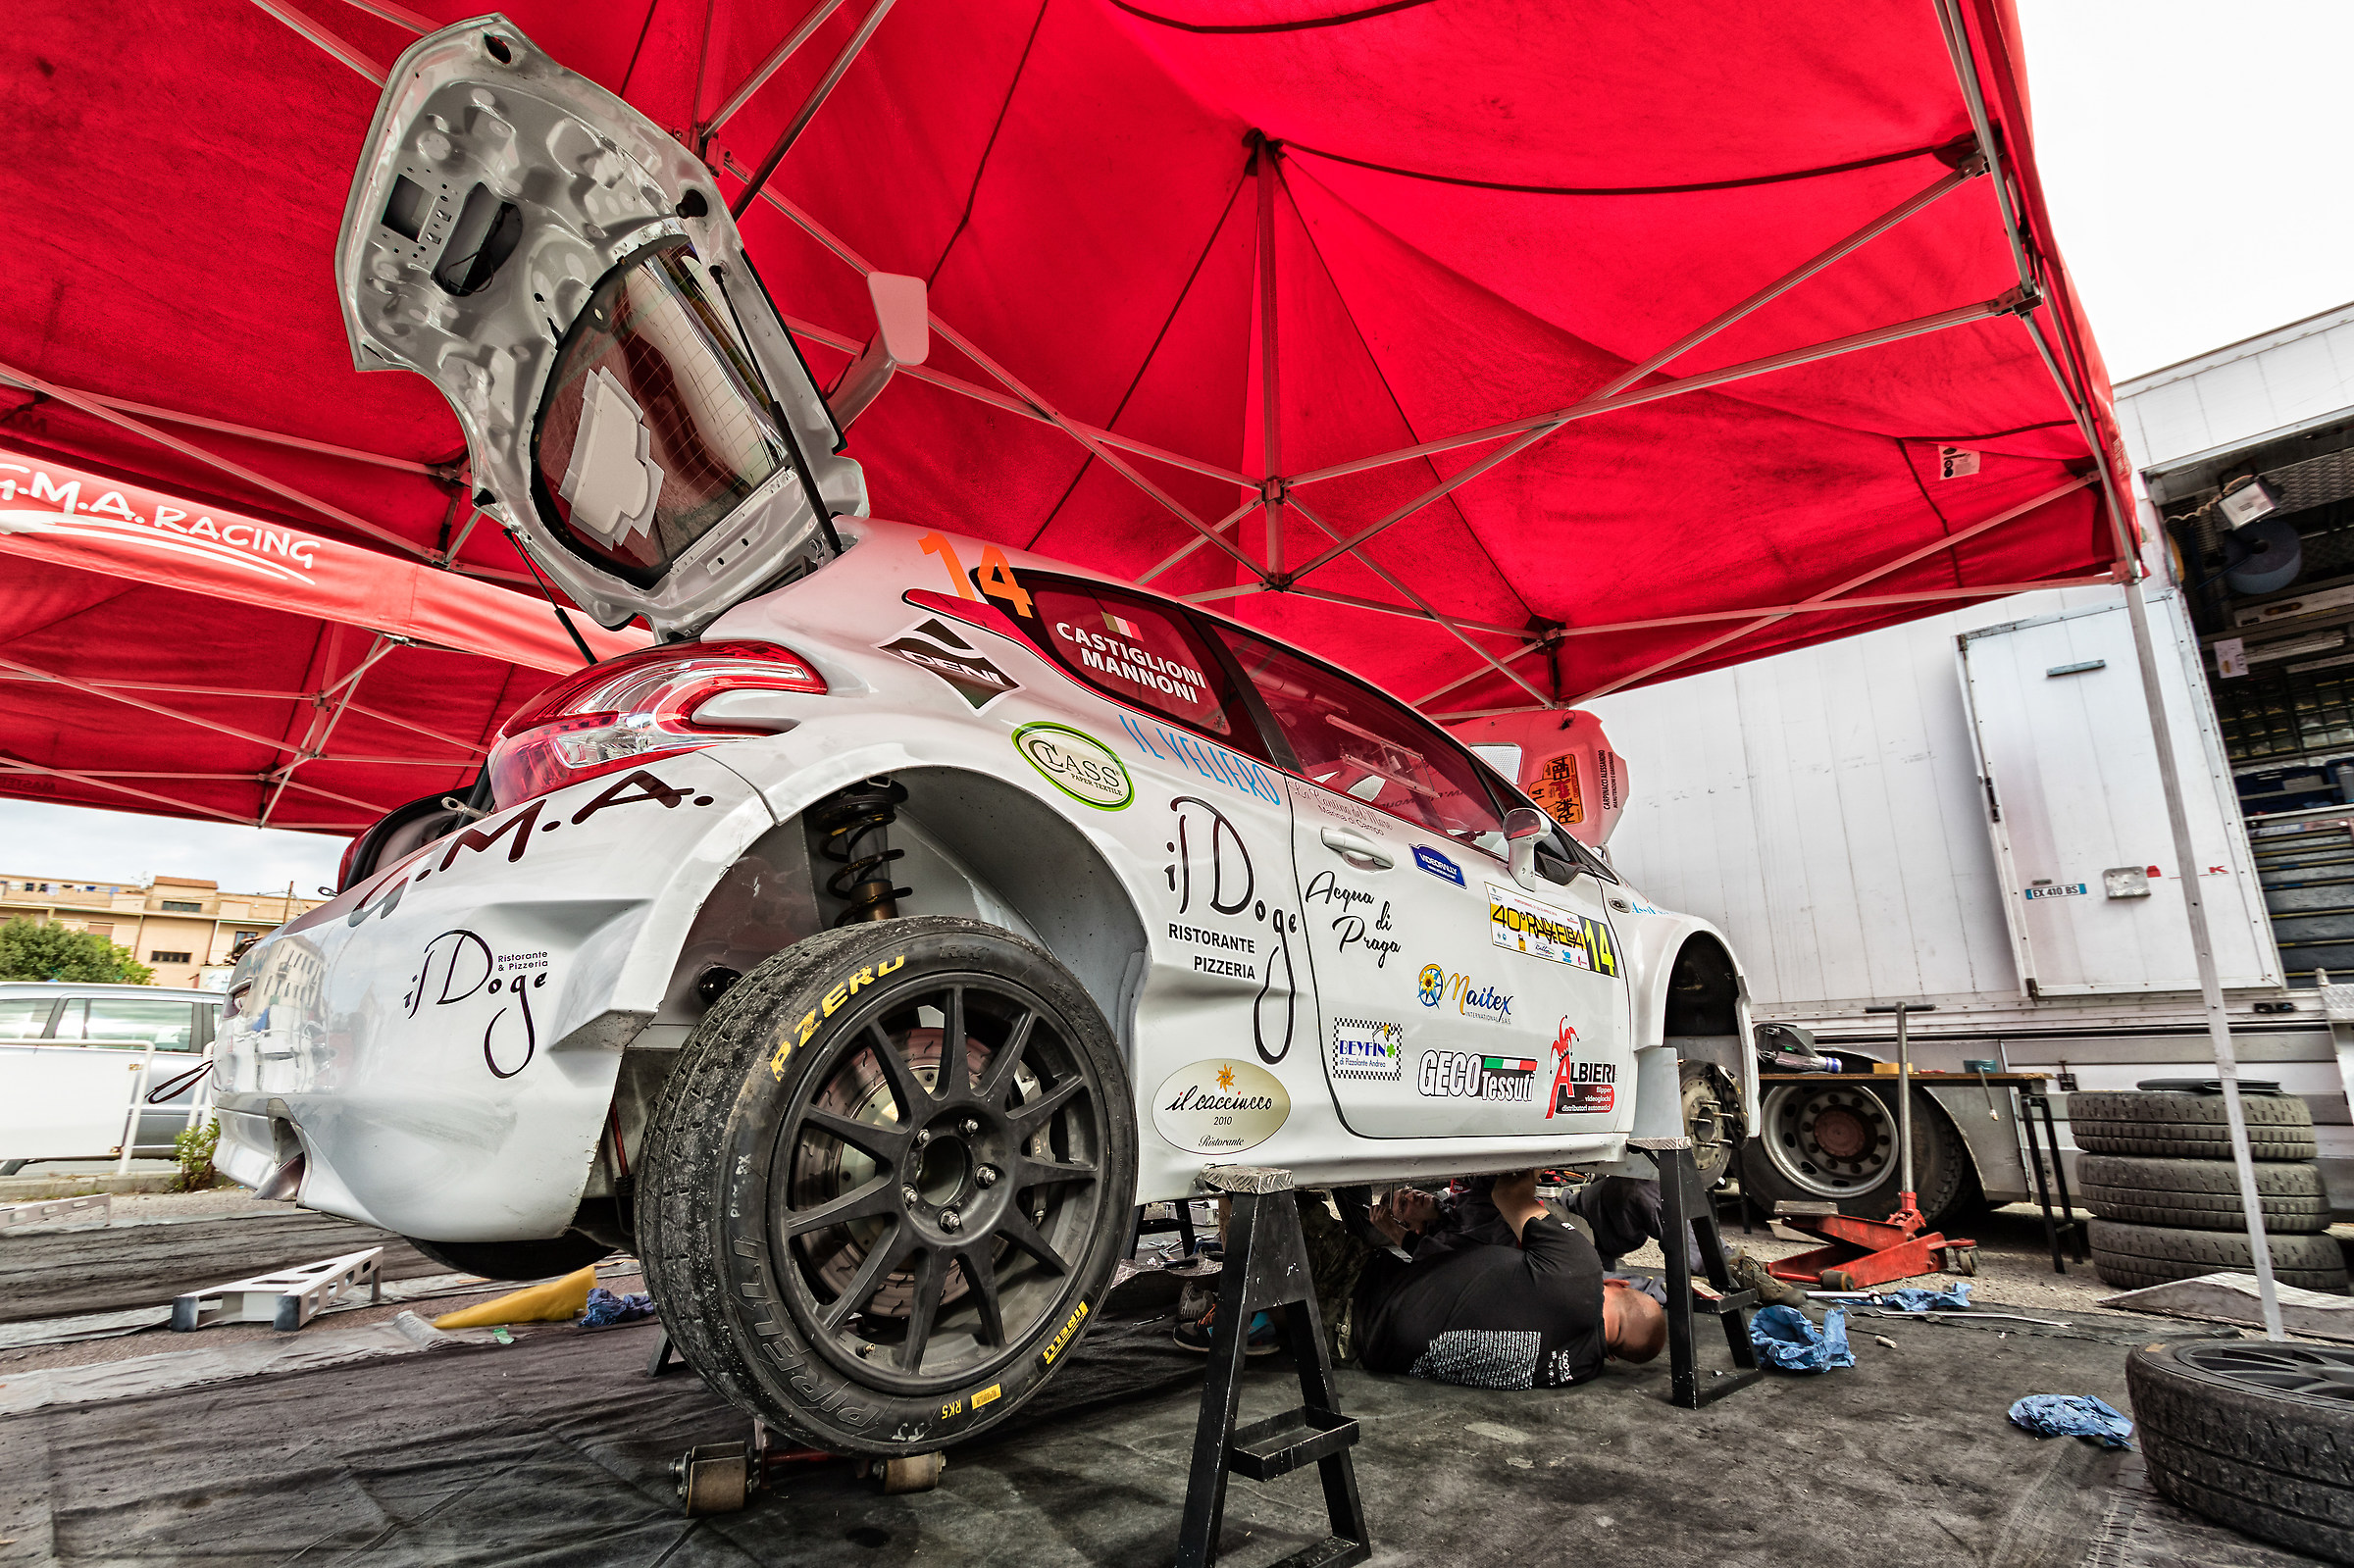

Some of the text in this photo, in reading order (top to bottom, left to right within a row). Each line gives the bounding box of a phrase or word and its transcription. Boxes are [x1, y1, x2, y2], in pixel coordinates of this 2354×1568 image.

[154, 505, 321, 569] RACING
[918, 531, 1033, 618] 14
[1055, 622, 1206, 689] CASTIGLIONI
[1080, 646, 1199, 704] MANNONI
[1118, 714, 1281, 806] IL VELIERO
[1305, 870, 1375, 913] Acqua
[2032, 885, 2078, 898] EX 410 BS
[1168, 923, 1255, 954] RISTORANTE
[1170, 795, 1297, 1066] Doge
[1375, 900, 1393, 932] di
[497, 950, 548, 963] Ristorante
[1331, 914, 1402, 969] Praga
[1584, 918, 1614, 977] 14
[508, 959, 548, 971] Pizzeria
[1194, 955, 1255, 980] PIZZERIA
[424, 929, 547, 1080] Doge
[1439, 972, 1514, 1022] Maitex
[1464, 1011, 1499, 1023] INTERNATIONAL
[1339, 1039, 1386, 1057] BEYFIN
[1165, 1085, 1272, 1111] il cacciucco
[1417, 1049, 1536, 1102] GECO Tessuti
[1545, 1053, 1616, 1119] ALBIERI
[1198, 1135, 1245, 1147] Ristorante
[1213, 1116, 1233, 1126] 2010
